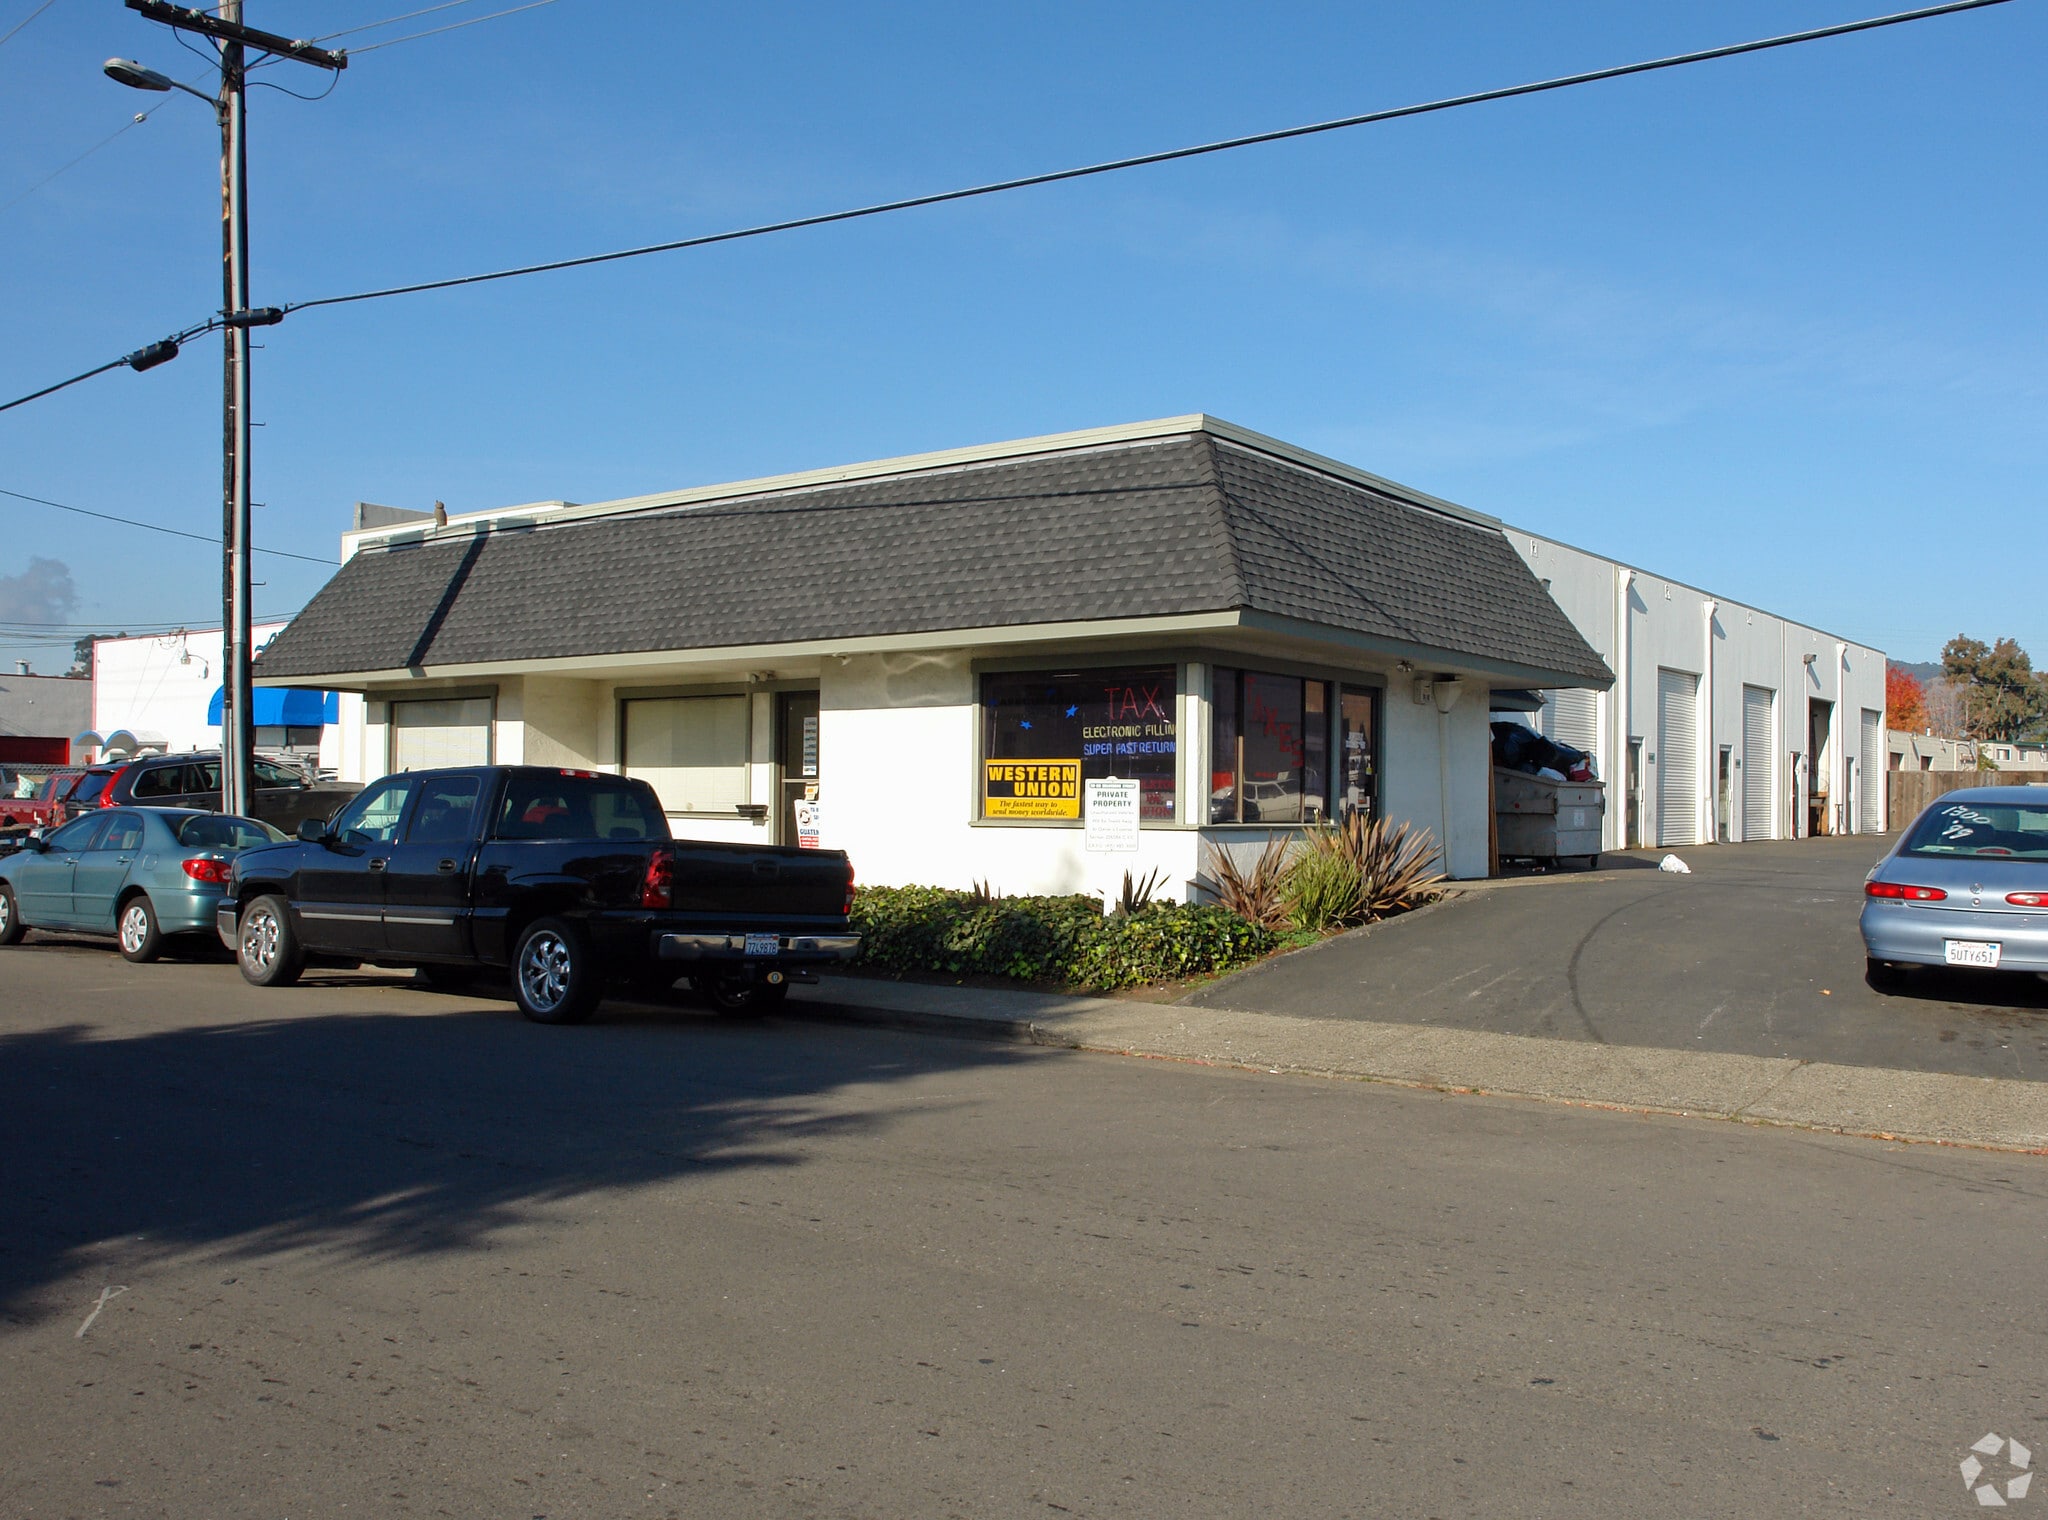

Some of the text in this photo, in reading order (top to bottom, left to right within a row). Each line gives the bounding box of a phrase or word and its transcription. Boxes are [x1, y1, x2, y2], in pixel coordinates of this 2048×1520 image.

[1104, 685, 1161, 720] TAX
[1245, 677, 1304, 767] TAXES
[1082, 725, 1141, 738] ELECTRONIC
[1083, 743, 1113, 756] SUPER
[1116, 741, 1138, 754] FAST
[988, 766, 1075, 781] WESTERN
[1014, 782, 1075, 797] UNION
[1012, 800, 1034, 808] fastest
[1008, 809, 1027, 817] money
[1950, 949, 1993, 963] 5UTY651
